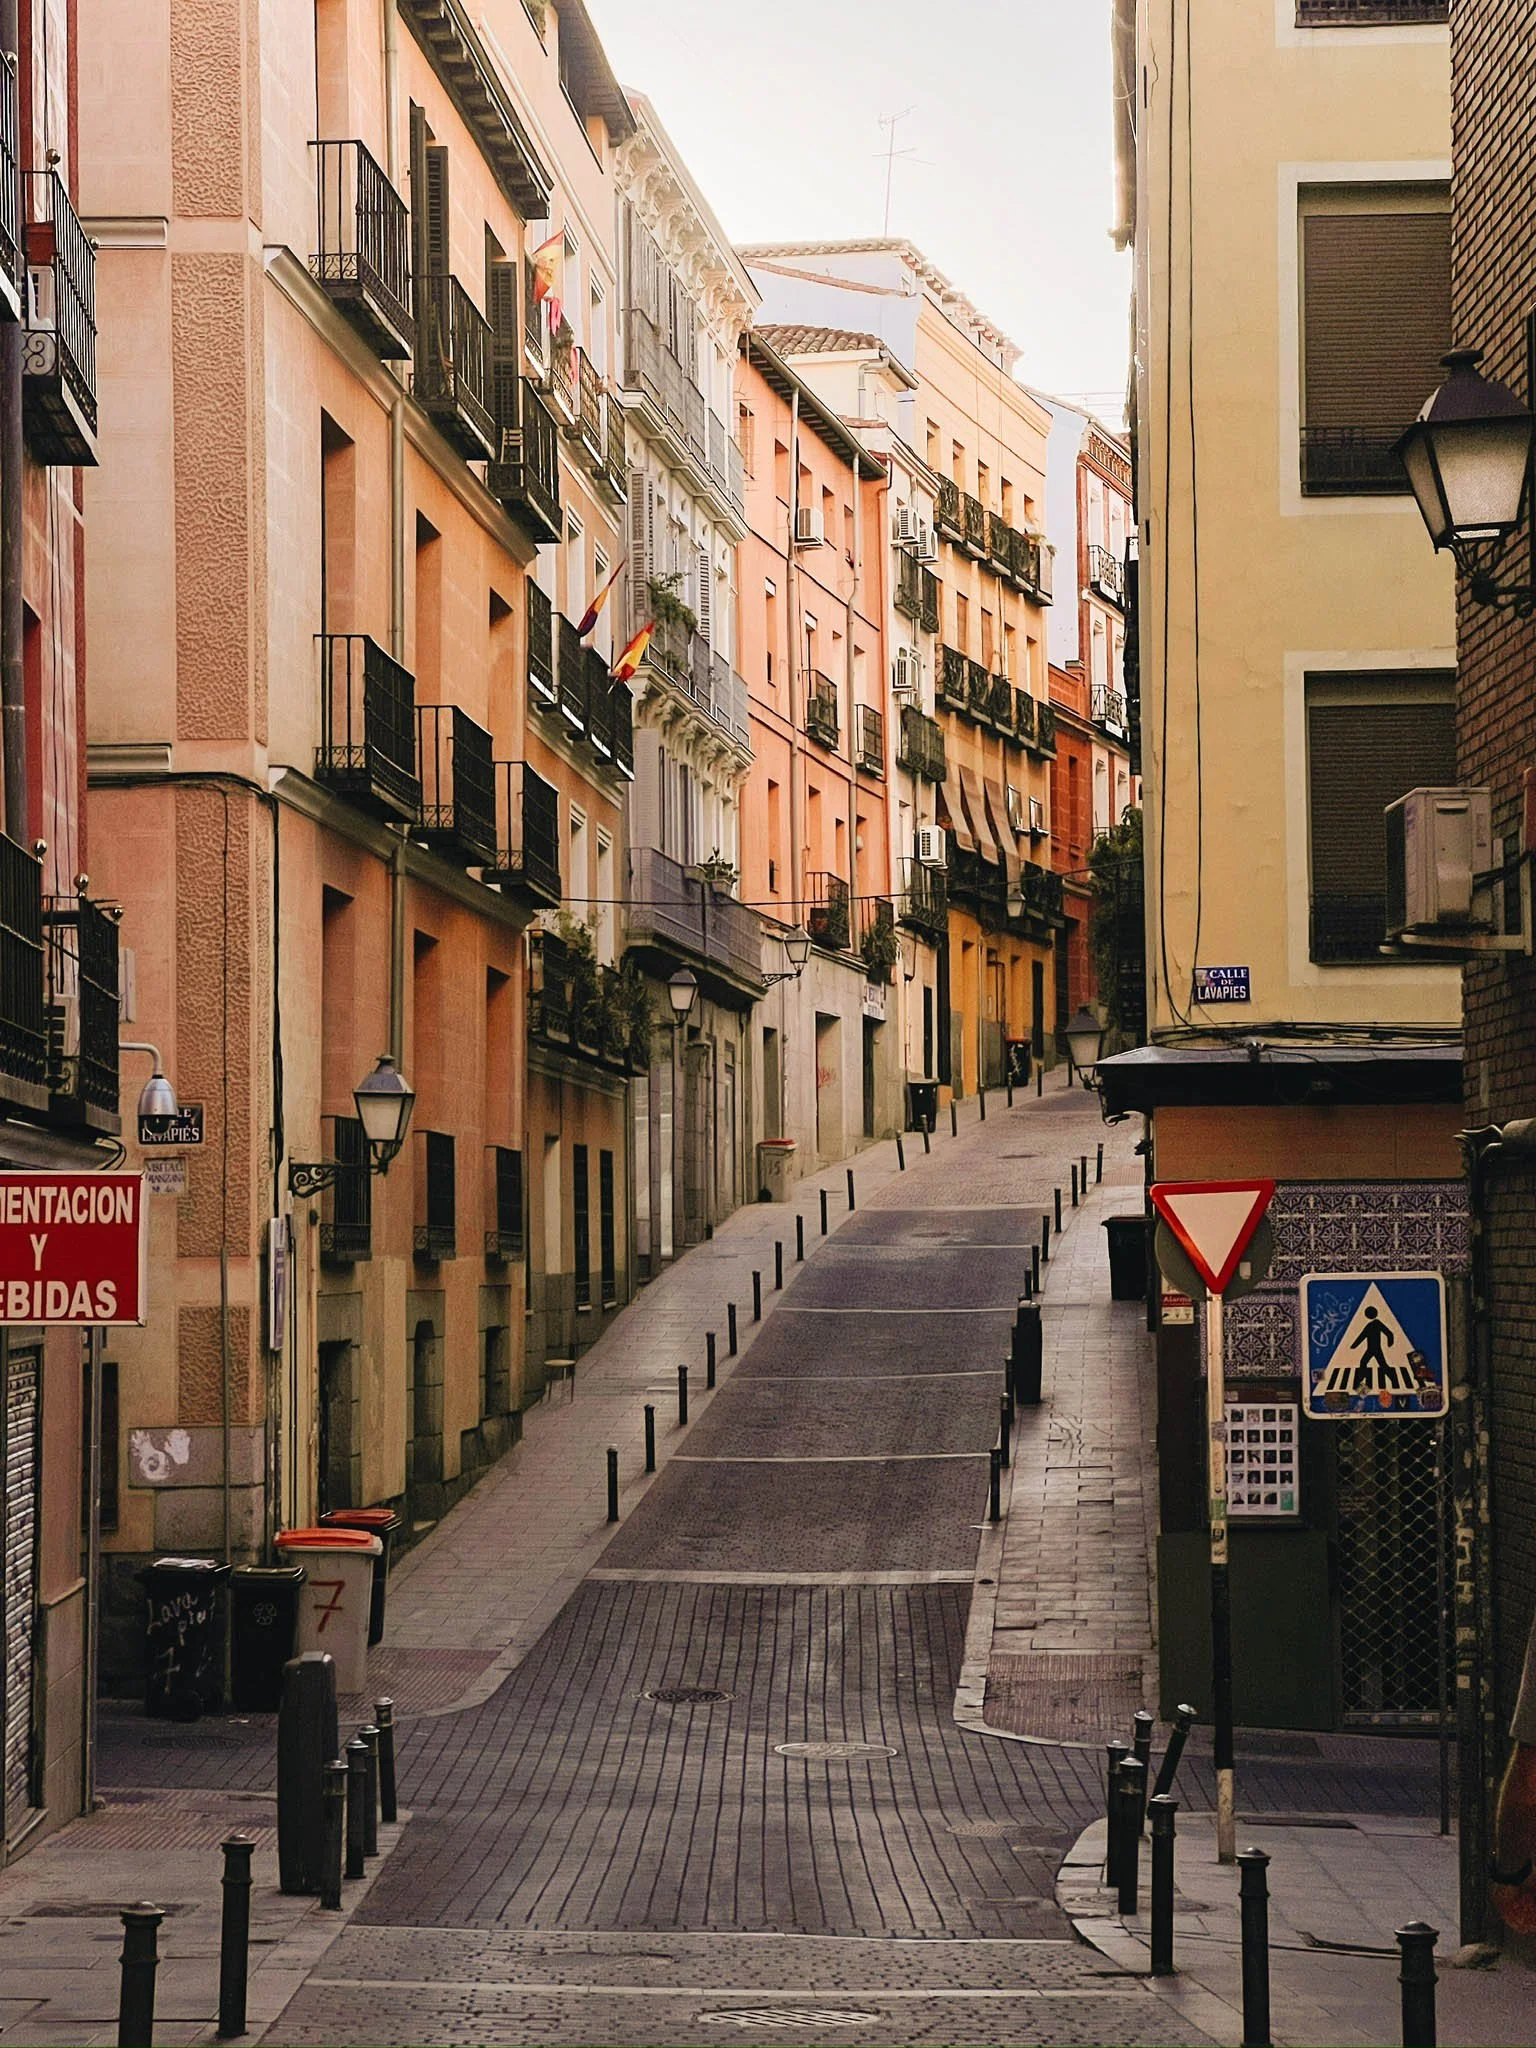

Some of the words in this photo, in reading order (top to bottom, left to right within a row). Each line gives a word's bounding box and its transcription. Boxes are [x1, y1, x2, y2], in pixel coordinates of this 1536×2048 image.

[1209, 968, 1247, 979] CALLE
[1197, 985, 1246, 1000] LAVAPIES
[0, 1186, 133, 1224] ENTACION
[30, 1234, 48, 1271] Y
[0, 1280, 117, 1319] BIDAS
[309, 1580, 345, 1632] 7
